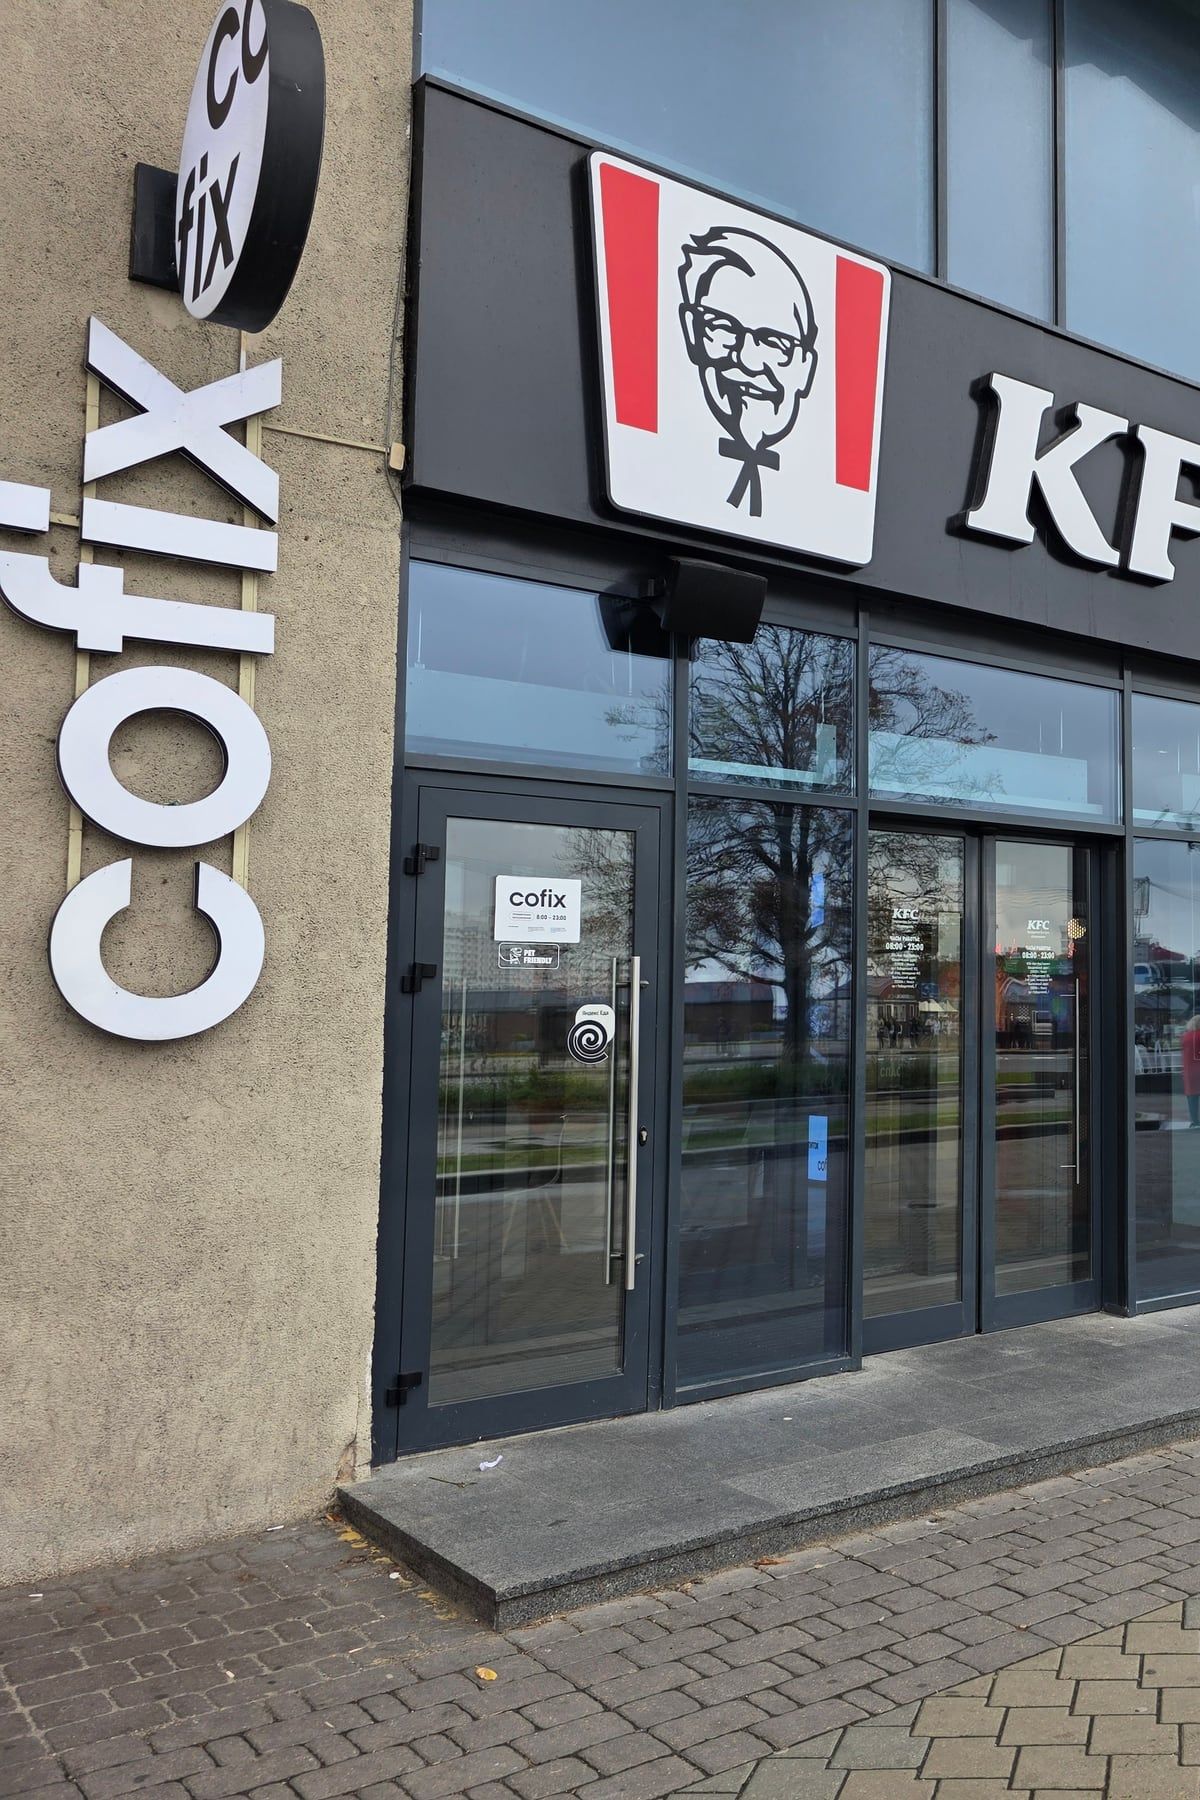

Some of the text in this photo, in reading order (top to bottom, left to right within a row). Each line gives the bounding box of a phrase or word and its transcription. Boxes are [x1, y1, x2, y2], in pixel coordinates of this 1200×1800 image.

[178, 151, 241, 304] fix
[0, 316, 282, 1041] cofix
[509, 888, 567, 908] cofix
[892, 908, 920, 920] KFC
[1027, 920, 1050, 930] KFC
[907, 943, 925, 951] 23:00
[524, 949, 536, 957] PET
[523, 956, 553, 965] FRIENDLY
